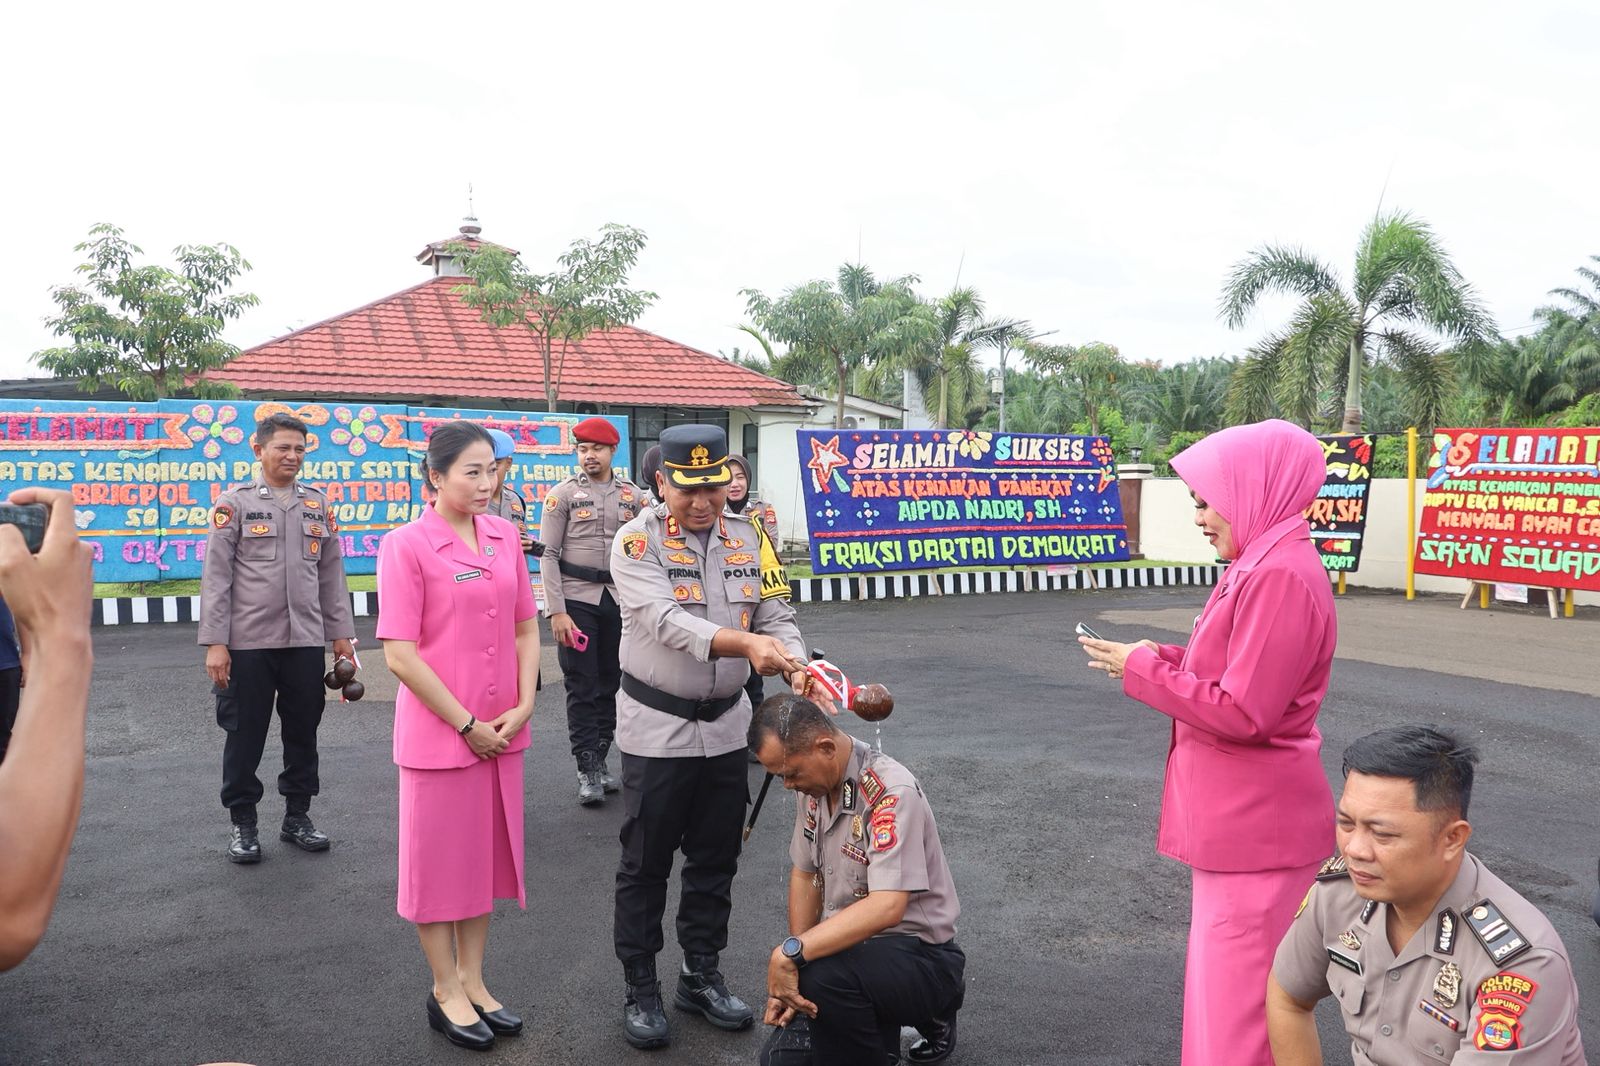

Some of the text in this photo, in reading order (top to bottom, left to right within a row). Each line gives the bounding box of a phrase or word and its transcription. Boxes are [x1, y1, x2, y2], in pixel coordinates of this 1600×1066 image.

[853, 436, 1084, 469] SELAMAT SUKSES
[1448, 433, 1600, 465] SELAMAT
[0, 462, 76, 480] ATAS
[84, 461, 227, 482] KENAIKAN
[72, 483, 197, 506] BRIGPOL
[852, 479, 1073, 500] ATAS KENAIKAN PANGKAT
[1443, 480, 1478, 492] ATAS
[1480, 480, 1551, 495] KENAIKAN
[898, 500, 960, 521] AIPDA
[1467, 494, 1499, 511] EKA
[1437, 511, 1515, 531] MENYALA
[1522, 515, 1573, 535] AYAH
[819, 534, 1117, 569] FRAKSI PARTAI DEMOKRAT
[1420, 540, 1492, 568] SAYN
[724, 567, 761, 579] POLRI
[1494, 938, 1522, 958] POLISI
[1481, 976, 1532, 992] POLRES
[1482, 999, 1521, 1012] LAMPUNG
